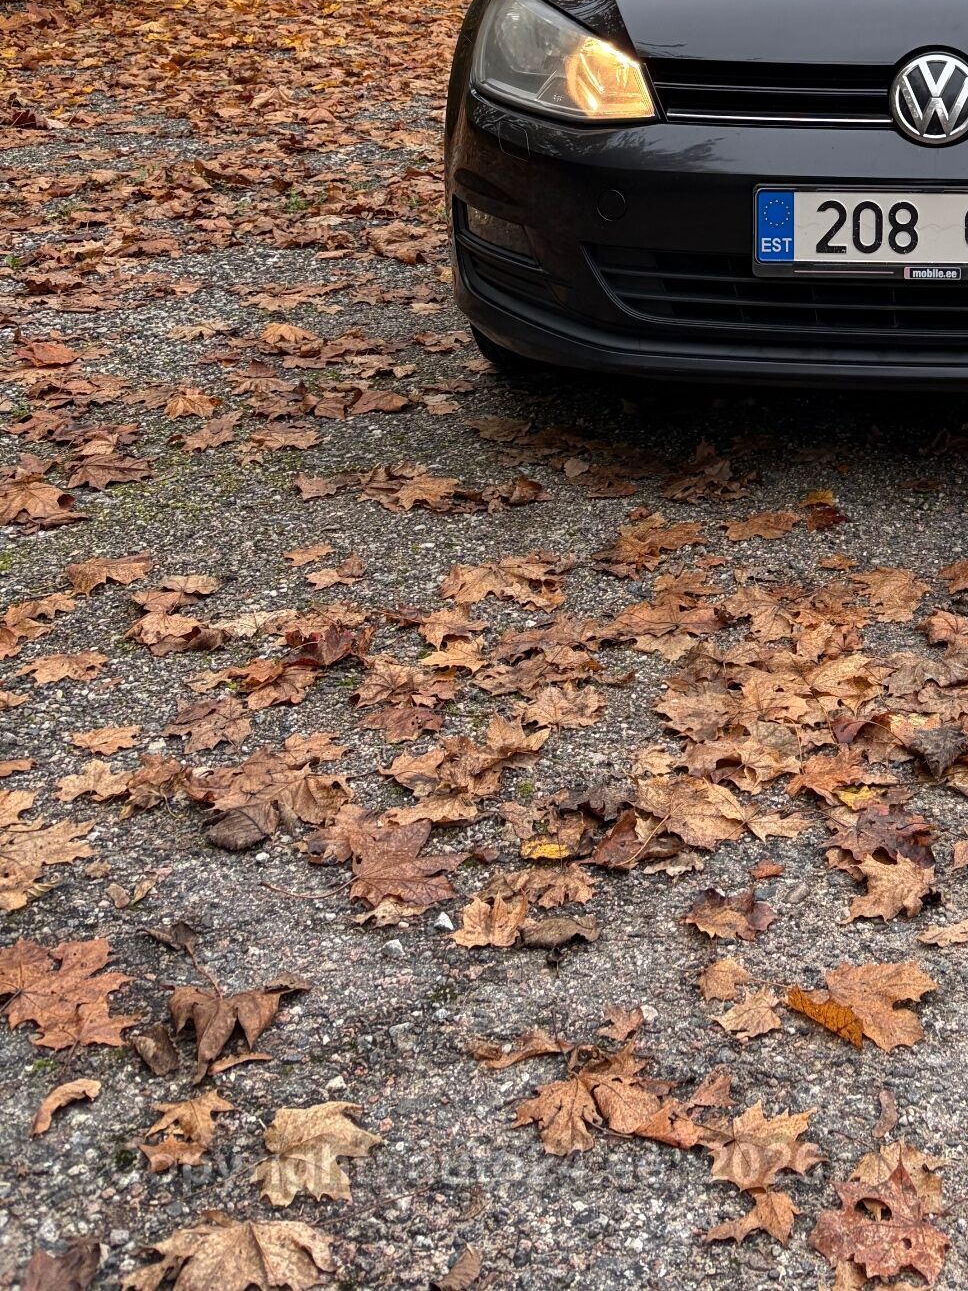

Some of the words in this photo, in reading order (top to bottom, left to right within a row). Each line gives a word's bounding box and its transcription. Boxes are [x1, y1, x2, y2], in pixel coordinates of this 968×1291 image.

[815, 200, 919, 255] 208
[761, 237, 792, 252] EST
[912, 268, 958, 278] mobile.ee
